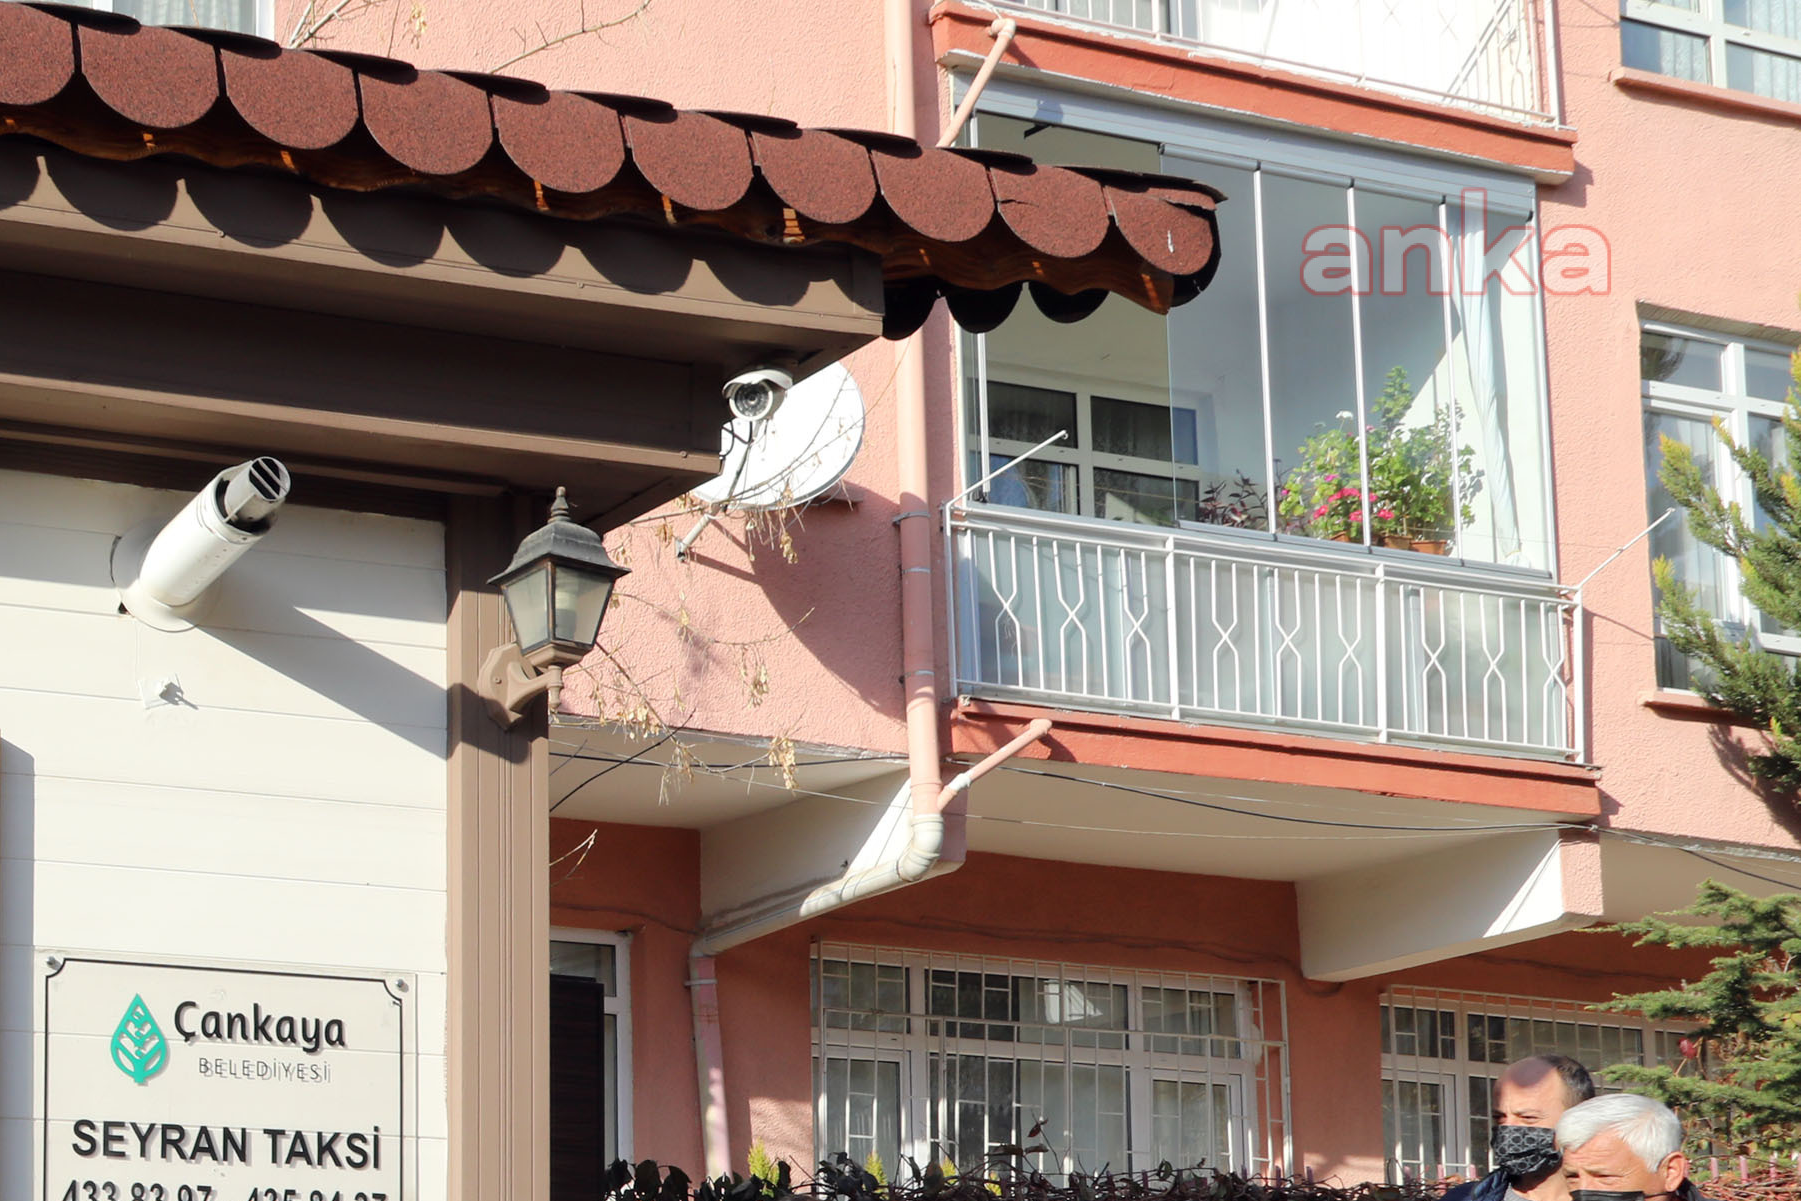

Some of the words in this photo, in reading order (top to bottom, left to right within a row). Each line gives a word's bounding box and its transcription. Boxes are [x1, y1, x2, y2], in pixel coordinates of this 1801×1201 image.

[174, 1000, 347, 1054] Çankaya
[199, 1057, 331, 1084] BELEDİYESİ
[72, 1120, 247, 1162] SEYRAN
[263, 1126, 381, 1169] TAKSİ
